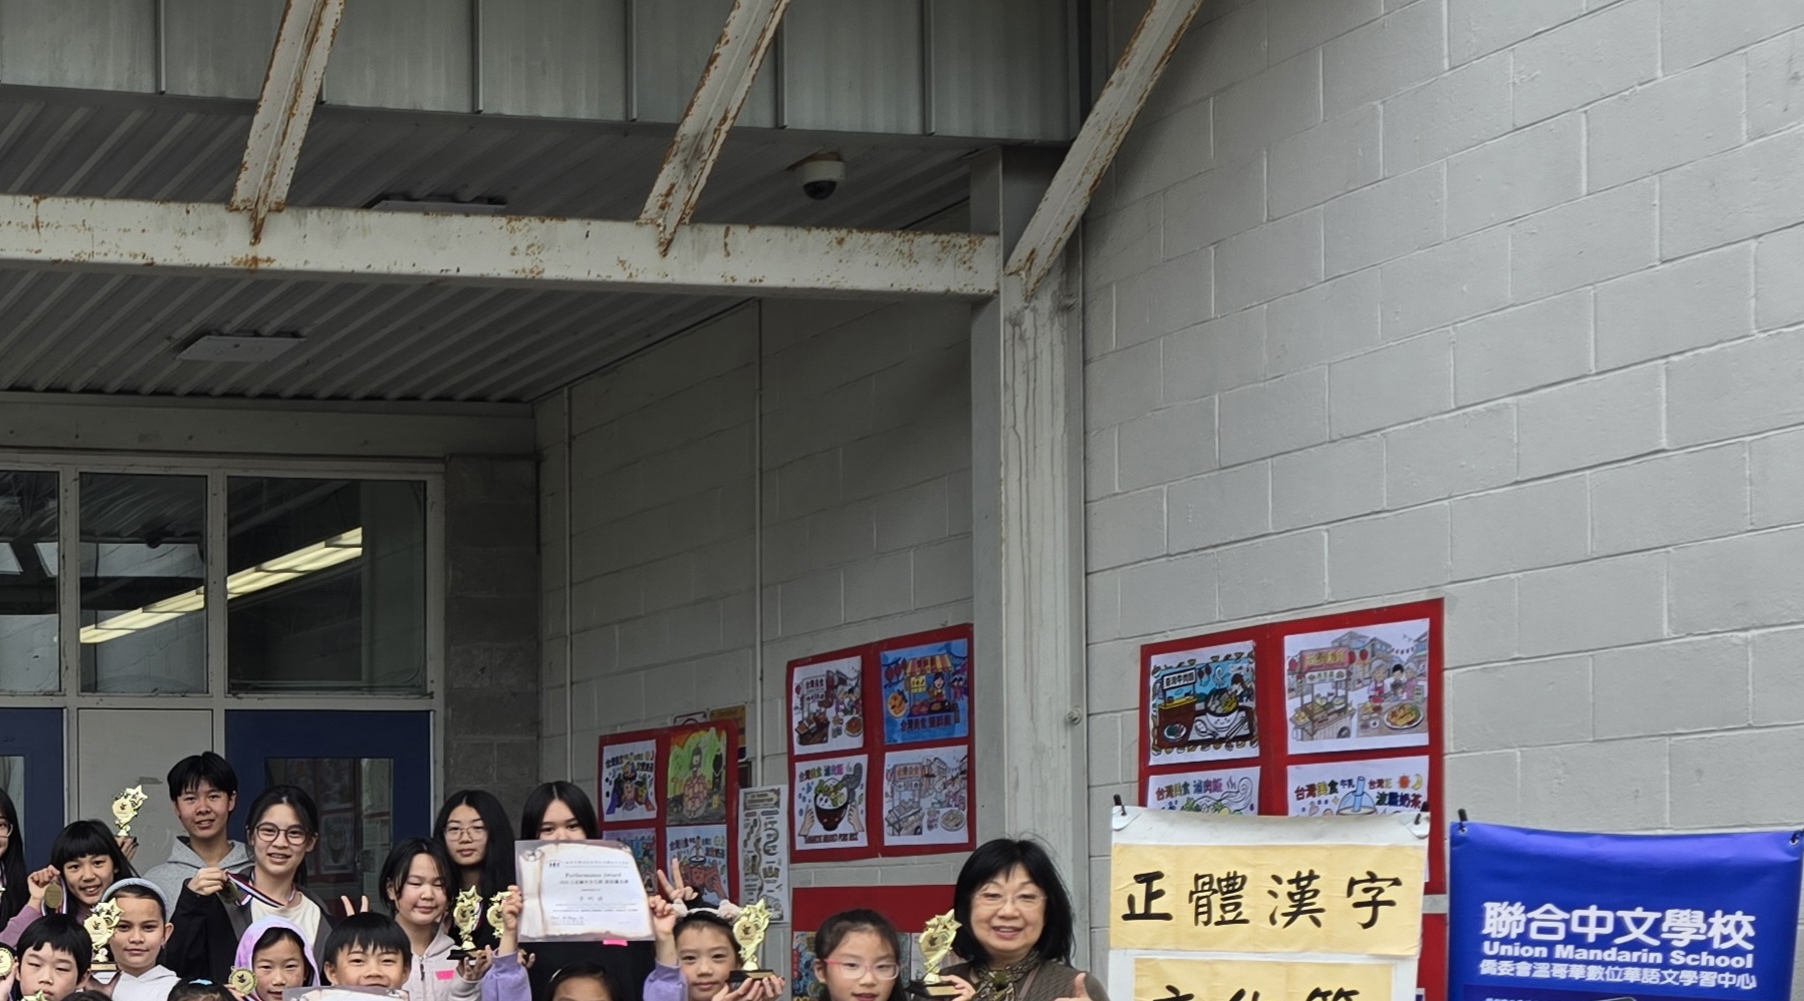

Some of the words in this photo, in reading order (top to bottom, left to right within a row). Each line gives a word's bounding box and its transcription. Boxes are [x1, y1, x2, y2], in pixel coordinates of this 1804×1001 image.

[1121, 869, 1403, 932] 正體漢字
[1481, 901, 1757, 951] 聯合中文學校
[1483, 940, 1548, 959] Union
[1555, 944, 1663, 964] Mandarin
[1670, 950, 1754, 969] School
